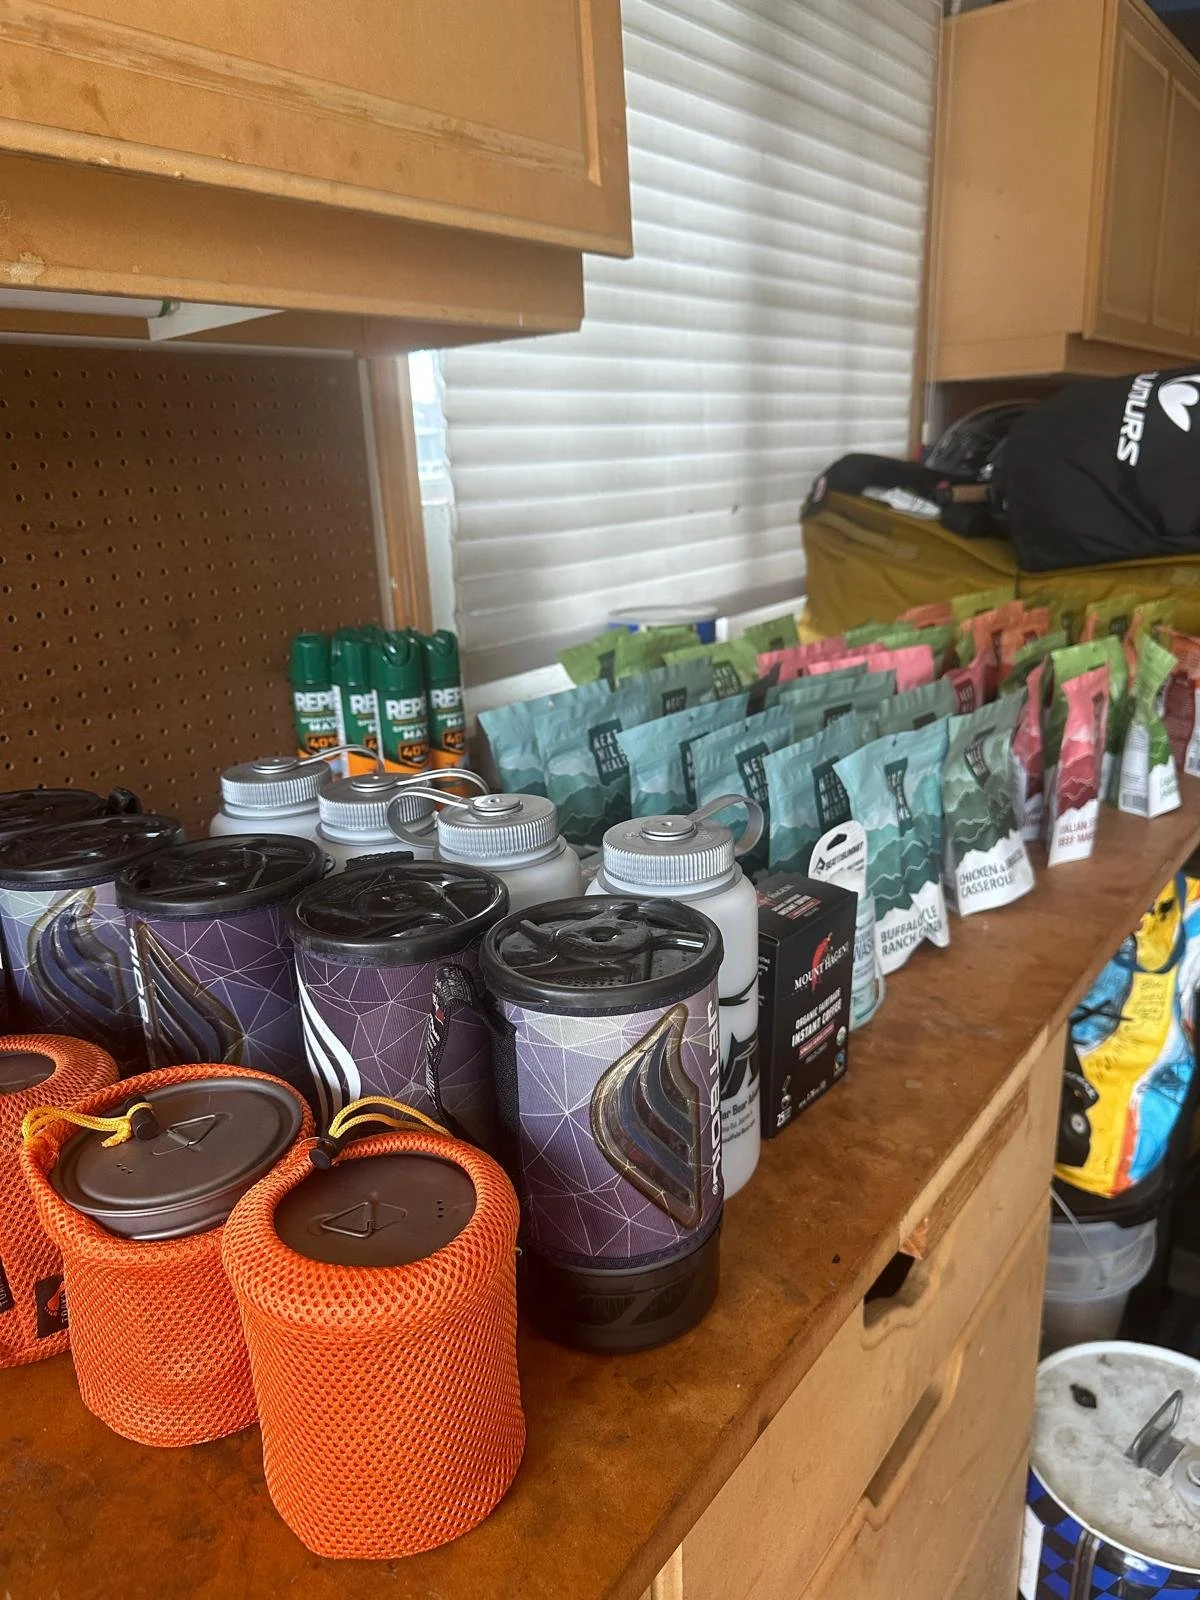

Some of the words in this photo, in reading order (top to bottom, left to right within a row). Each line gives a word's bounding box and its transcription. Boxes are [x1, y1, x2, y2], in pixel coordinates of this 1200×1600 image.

[294, 691, 336, 712] REP
[386, 698, 426, 720] REP
[431, 687, 462, 709] REP
[960, 862, 998, 886] CHICKEN
[881, 931, 917, 958] RANCH
[794, 962, 826, 991] MOUNT
[824, 940, 850, 971] HAGEN
[791, 1016, 821, 1048] INSTANT
[821, 998, 842, 1025] COFFEE
[708, 1000, 721, 1185] JETBOIL
